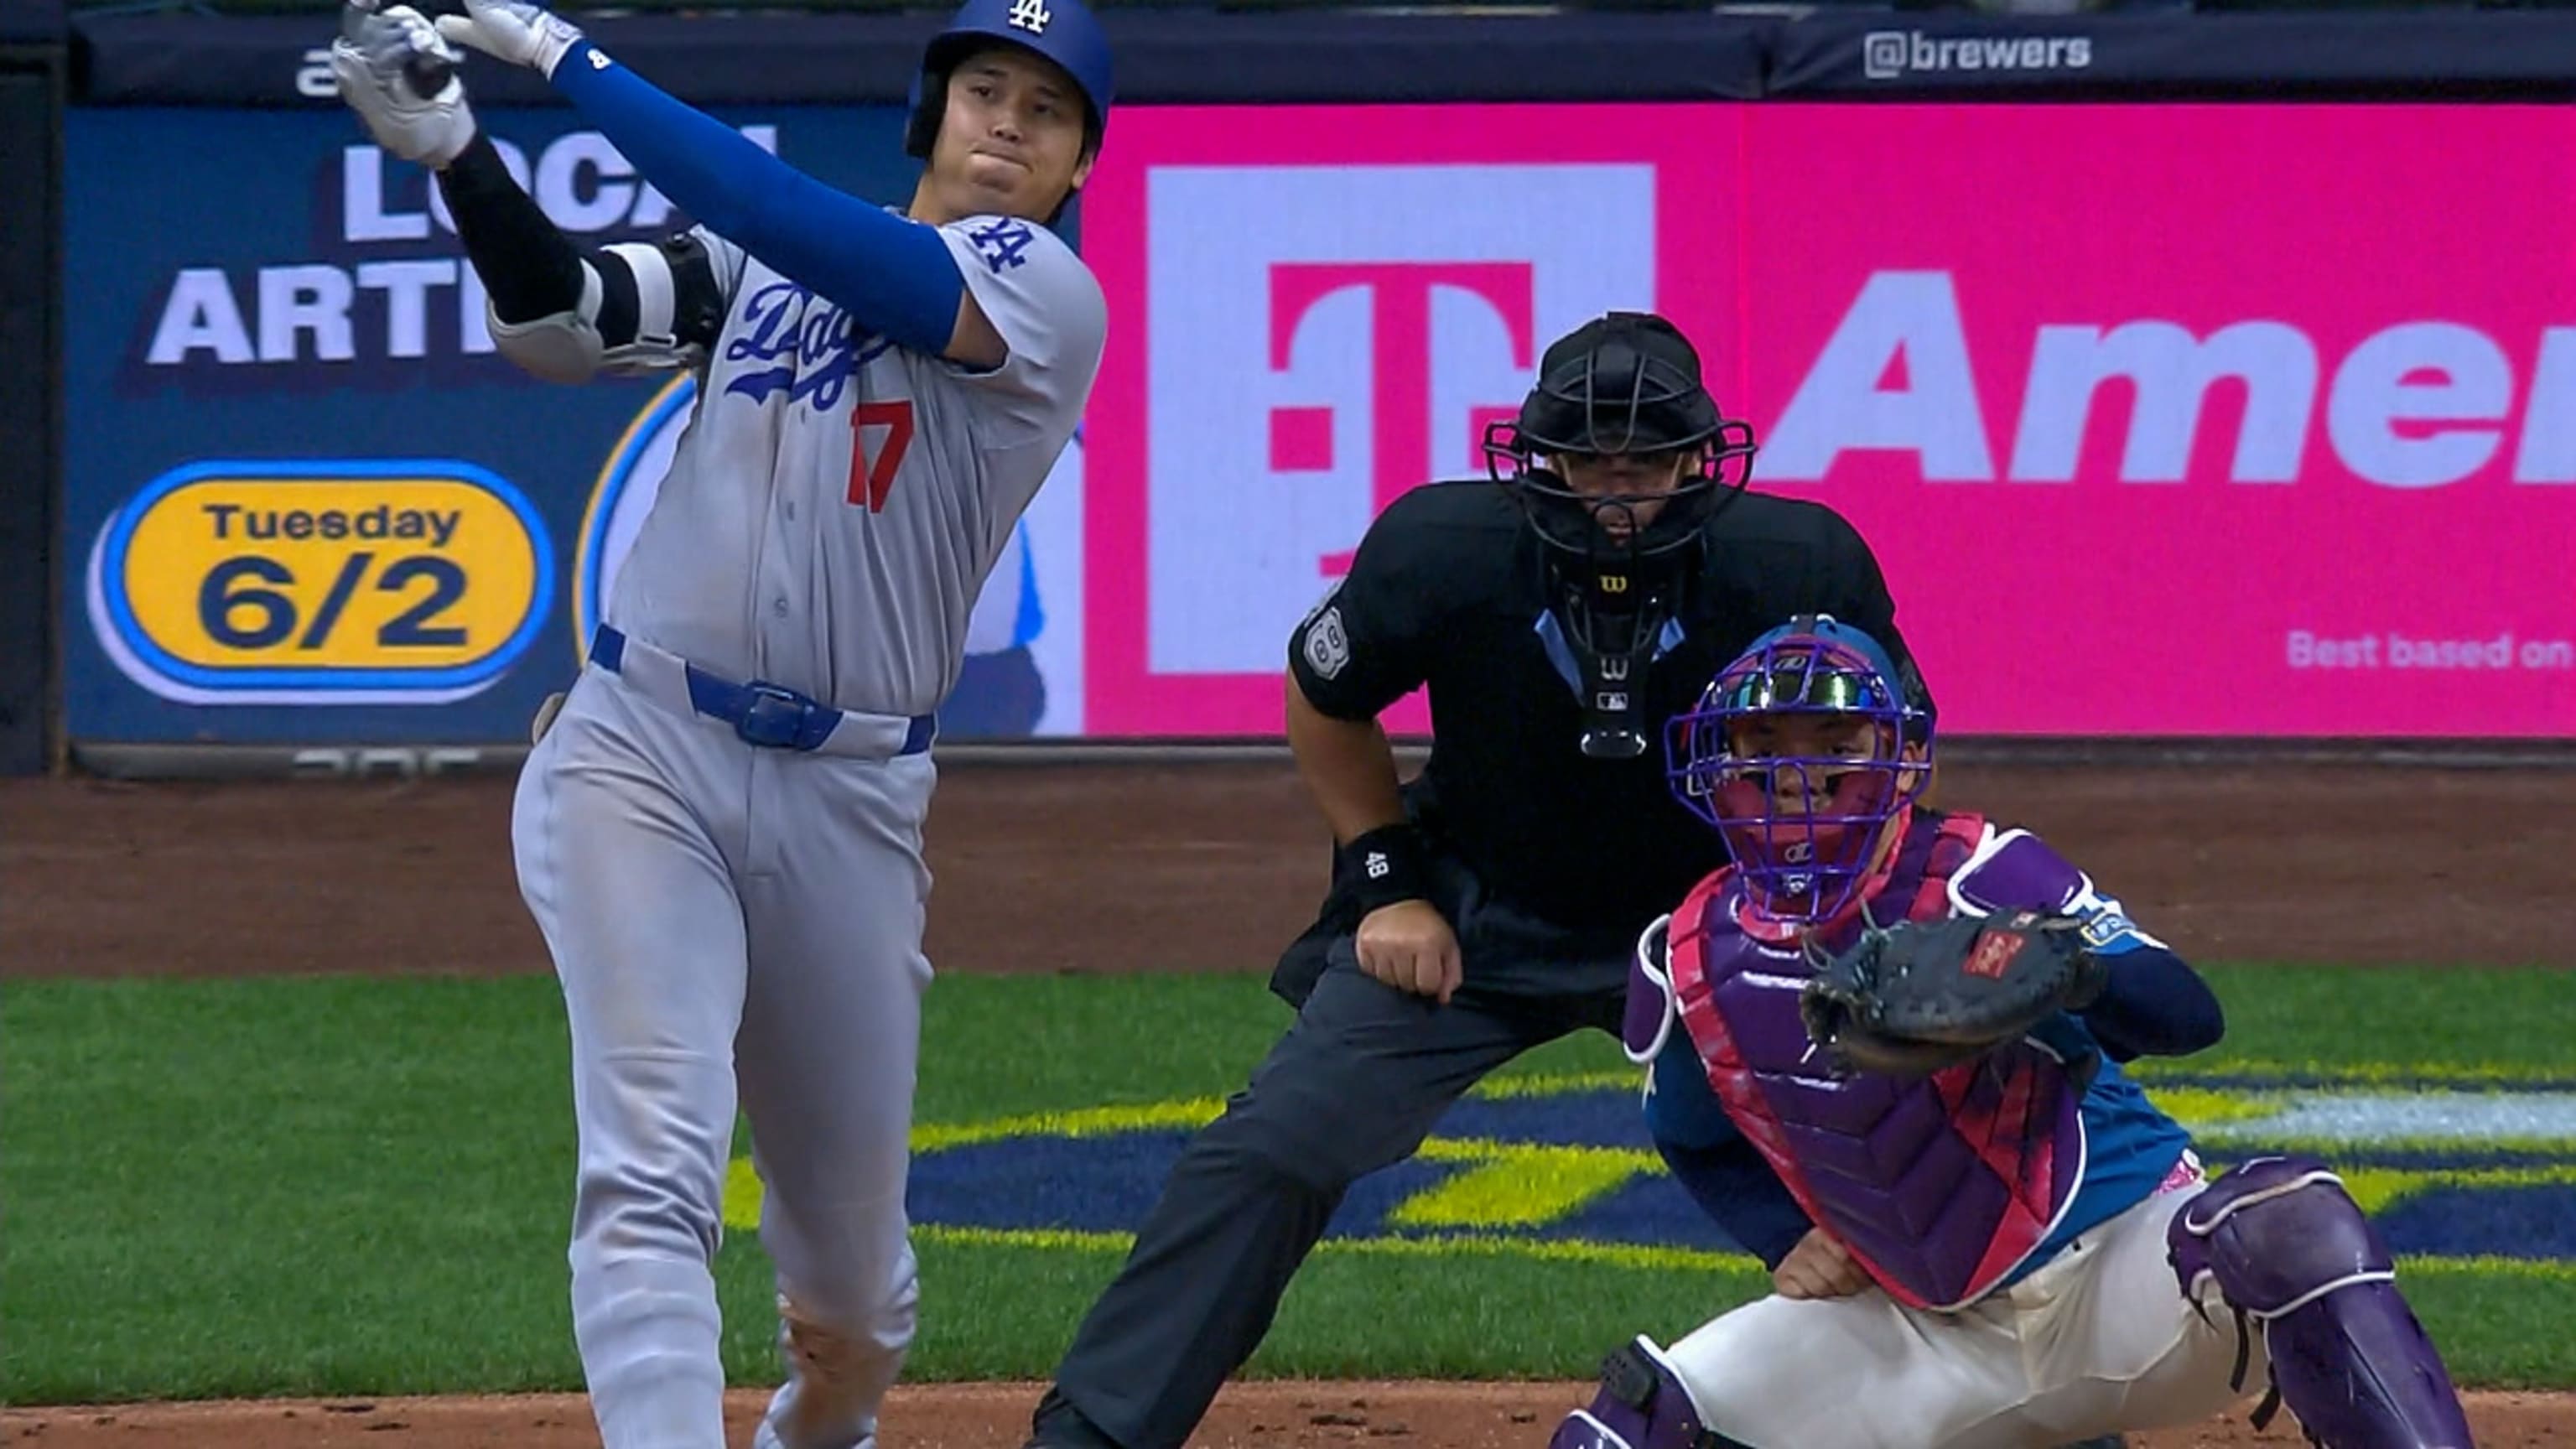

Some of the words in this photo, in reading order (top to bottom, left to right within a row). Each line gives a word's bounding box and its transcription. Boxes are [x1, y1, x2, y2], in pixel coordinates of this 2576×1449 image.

[1865, 30, 2092, 78] @brewers
[147, 258, 497, 364] ARTI
[847, 400, 914, 513] 17
[203, 504, 462, 547] Tuesday
[198, 552, 467, 650] 6/2
[2287, 631, 2378, 668] Best
[2389, 631, 2511, 668] based
[2520, 641, 2571, 668] on
[1365, 851, 1389, 879] 48
